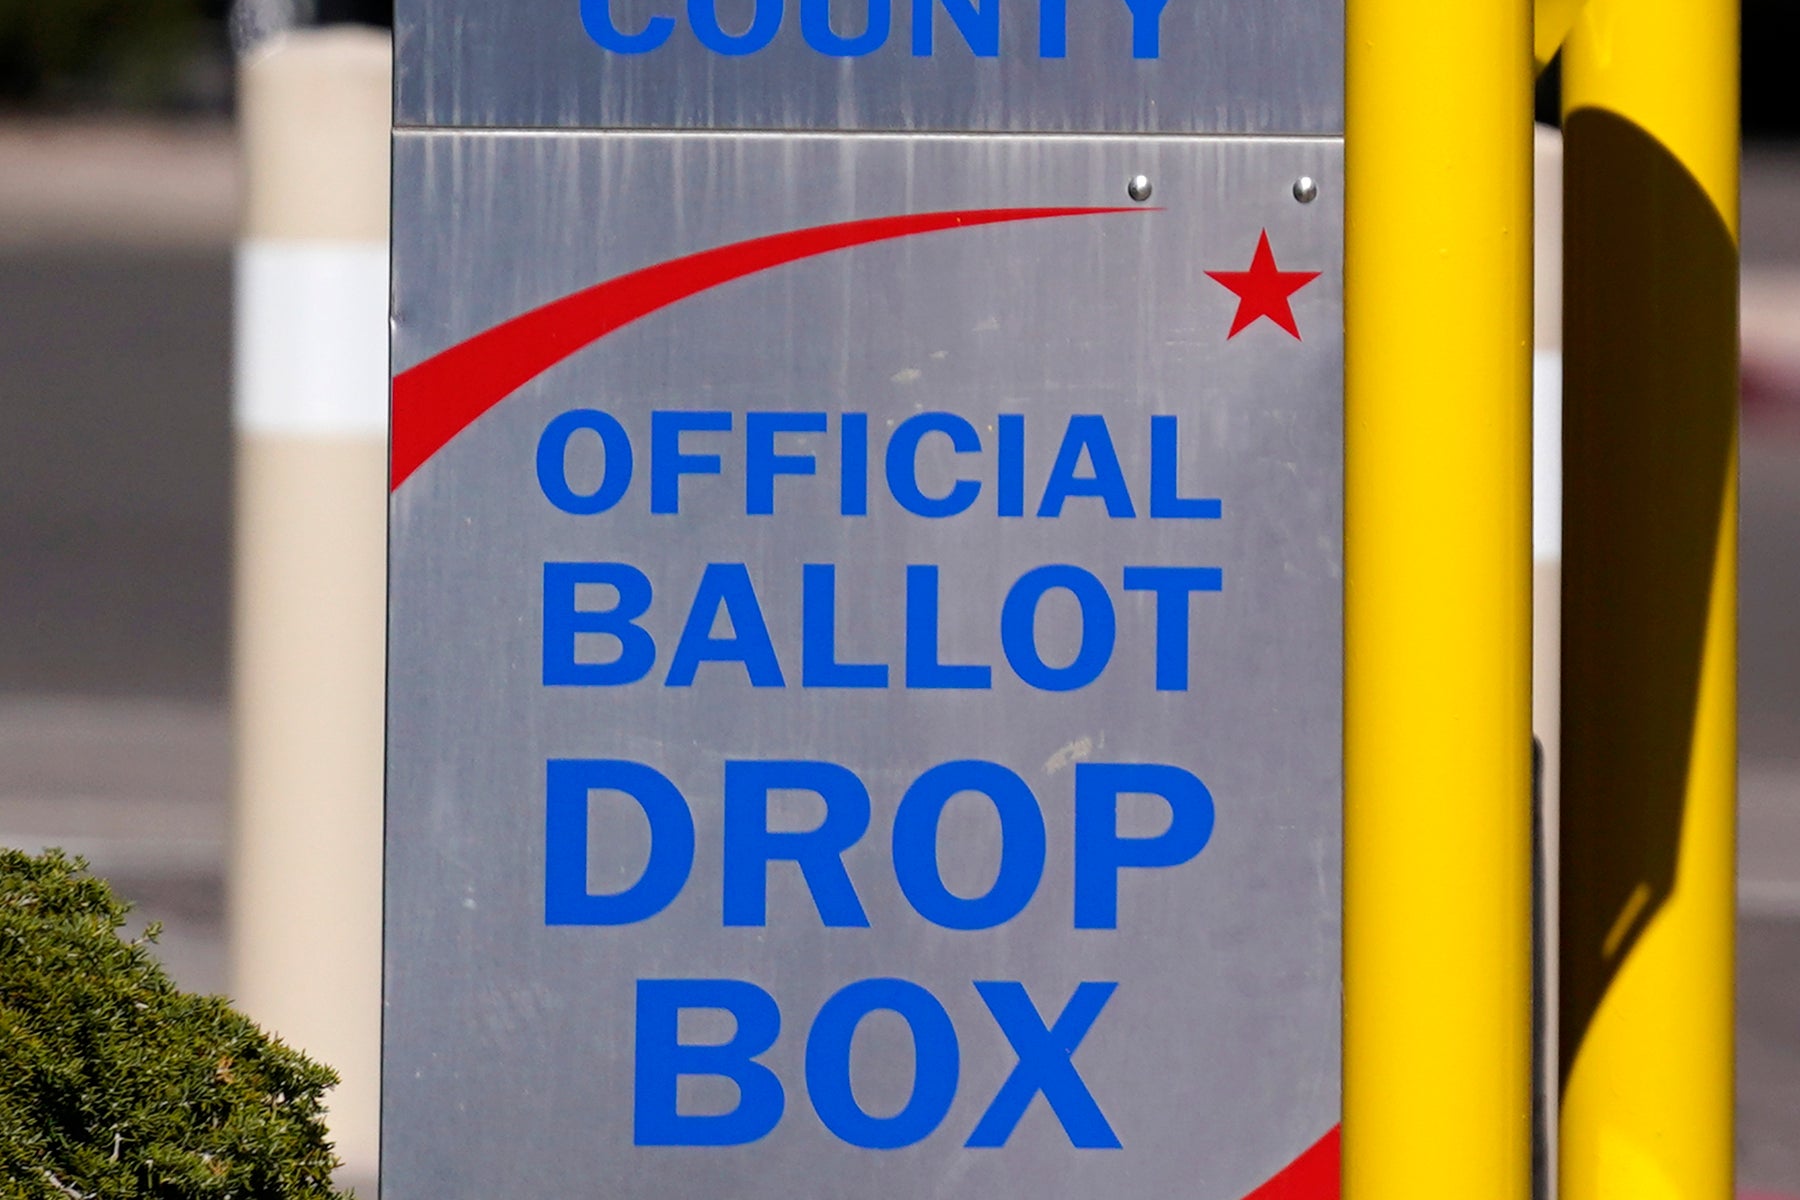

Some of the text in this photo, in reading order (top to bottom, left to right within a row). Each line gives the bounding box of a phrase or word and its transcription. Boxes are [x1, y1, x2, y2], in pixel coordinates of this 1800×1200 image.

[535, 408, 1223, 520] OFFICIAL
[541, 561, 1224, 692] BALLOT
[543, 757, 1216, 932] DROP
[632, 977, 1123, 1151] BOX
